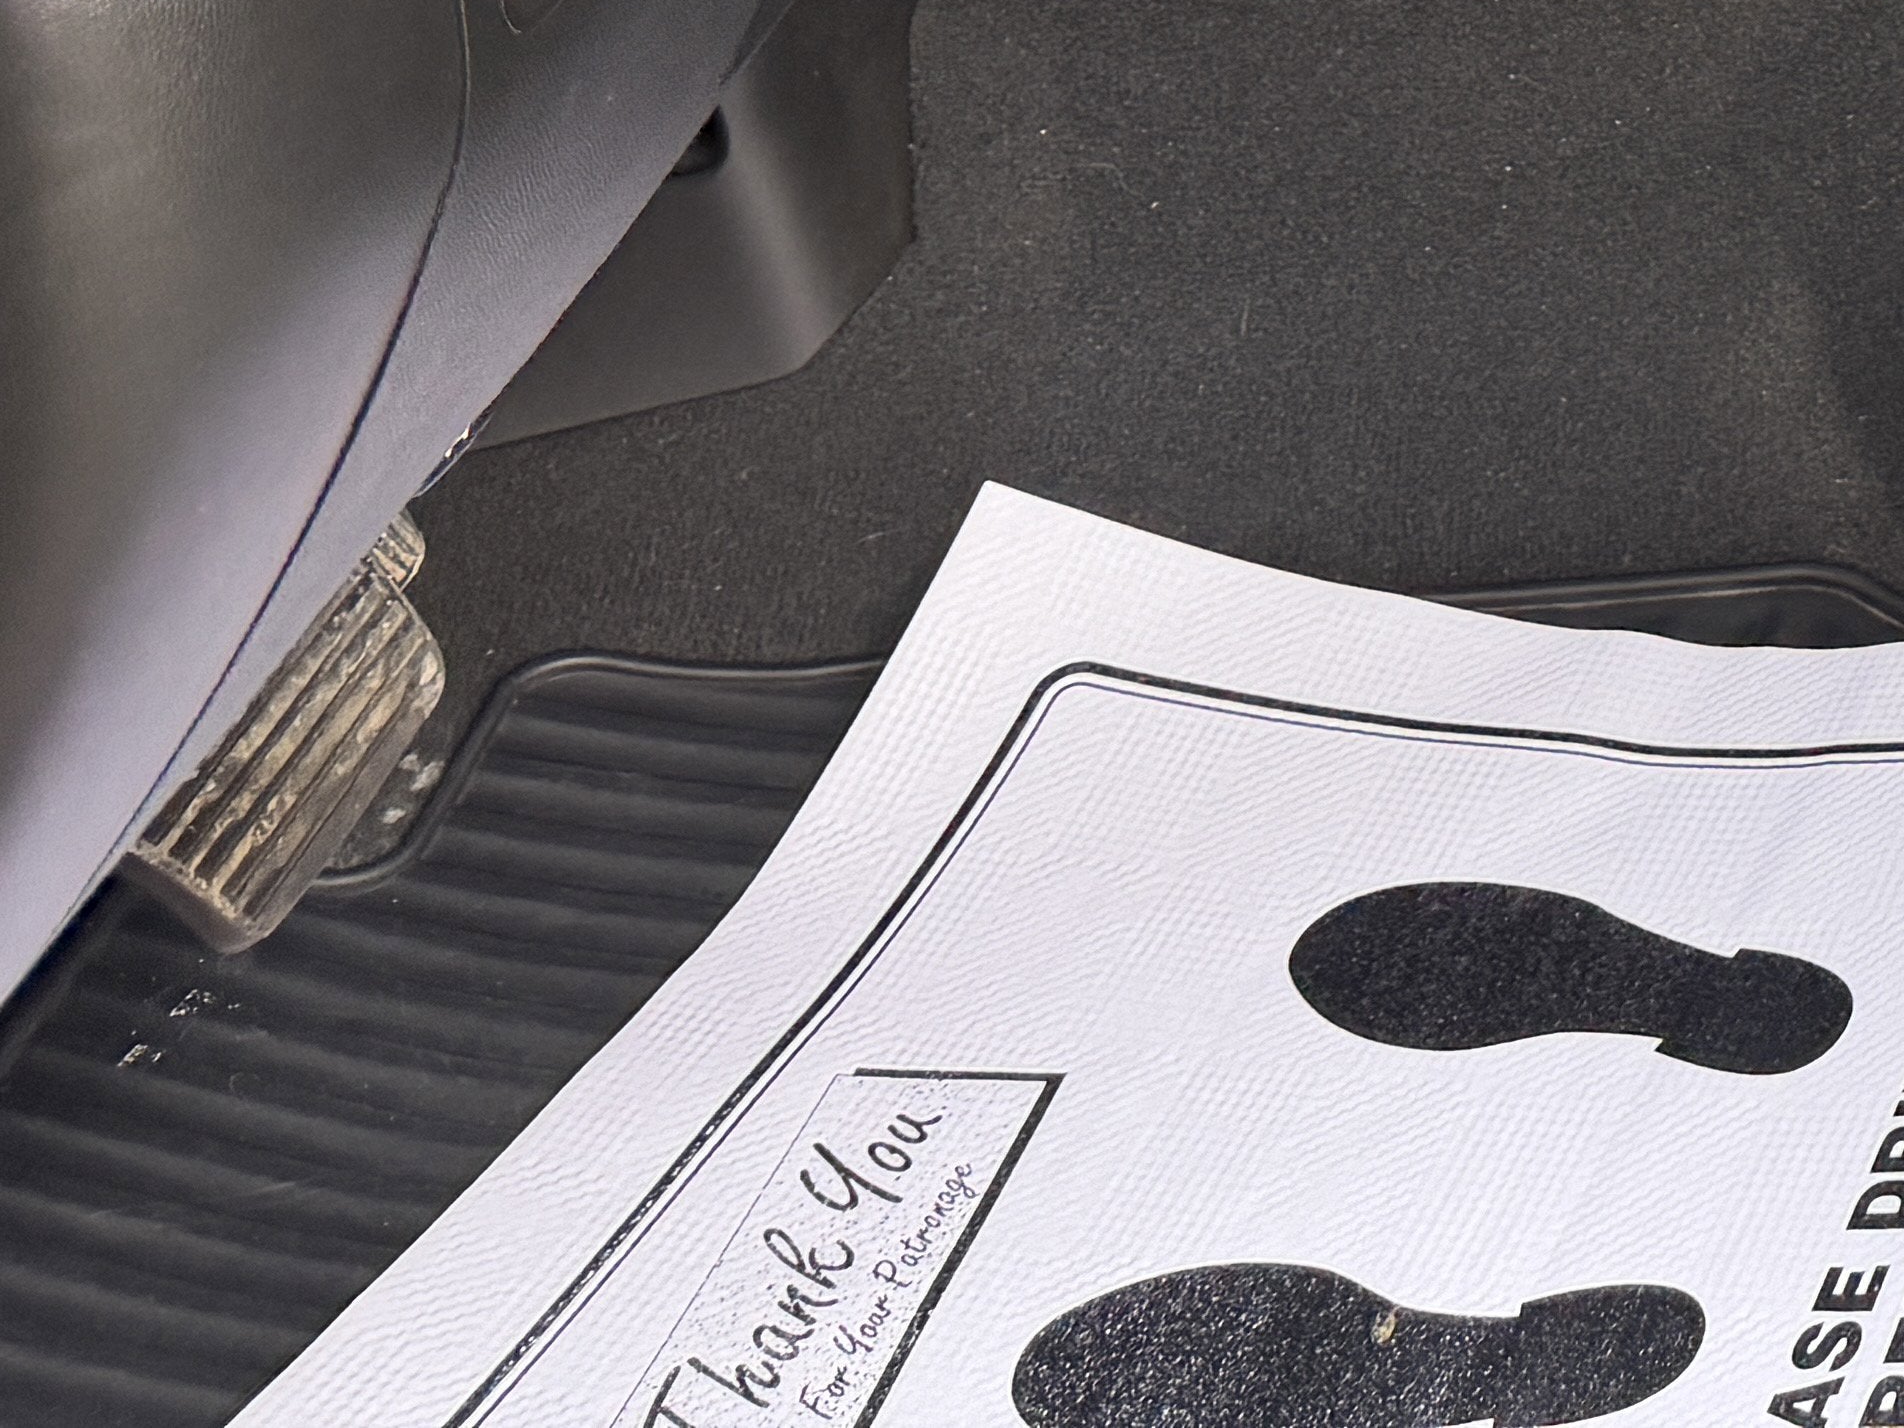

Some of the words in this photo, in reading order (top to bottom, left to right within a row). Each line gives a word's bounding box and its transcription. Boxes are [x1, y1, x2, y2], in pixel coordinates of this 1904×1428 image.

[642, 1227, 854, 1428] Thank
[800, 1112, 943, 1212] You
[799, 1365, 851, 1420] For
[872, 1162, 980, 1289] Patronage
